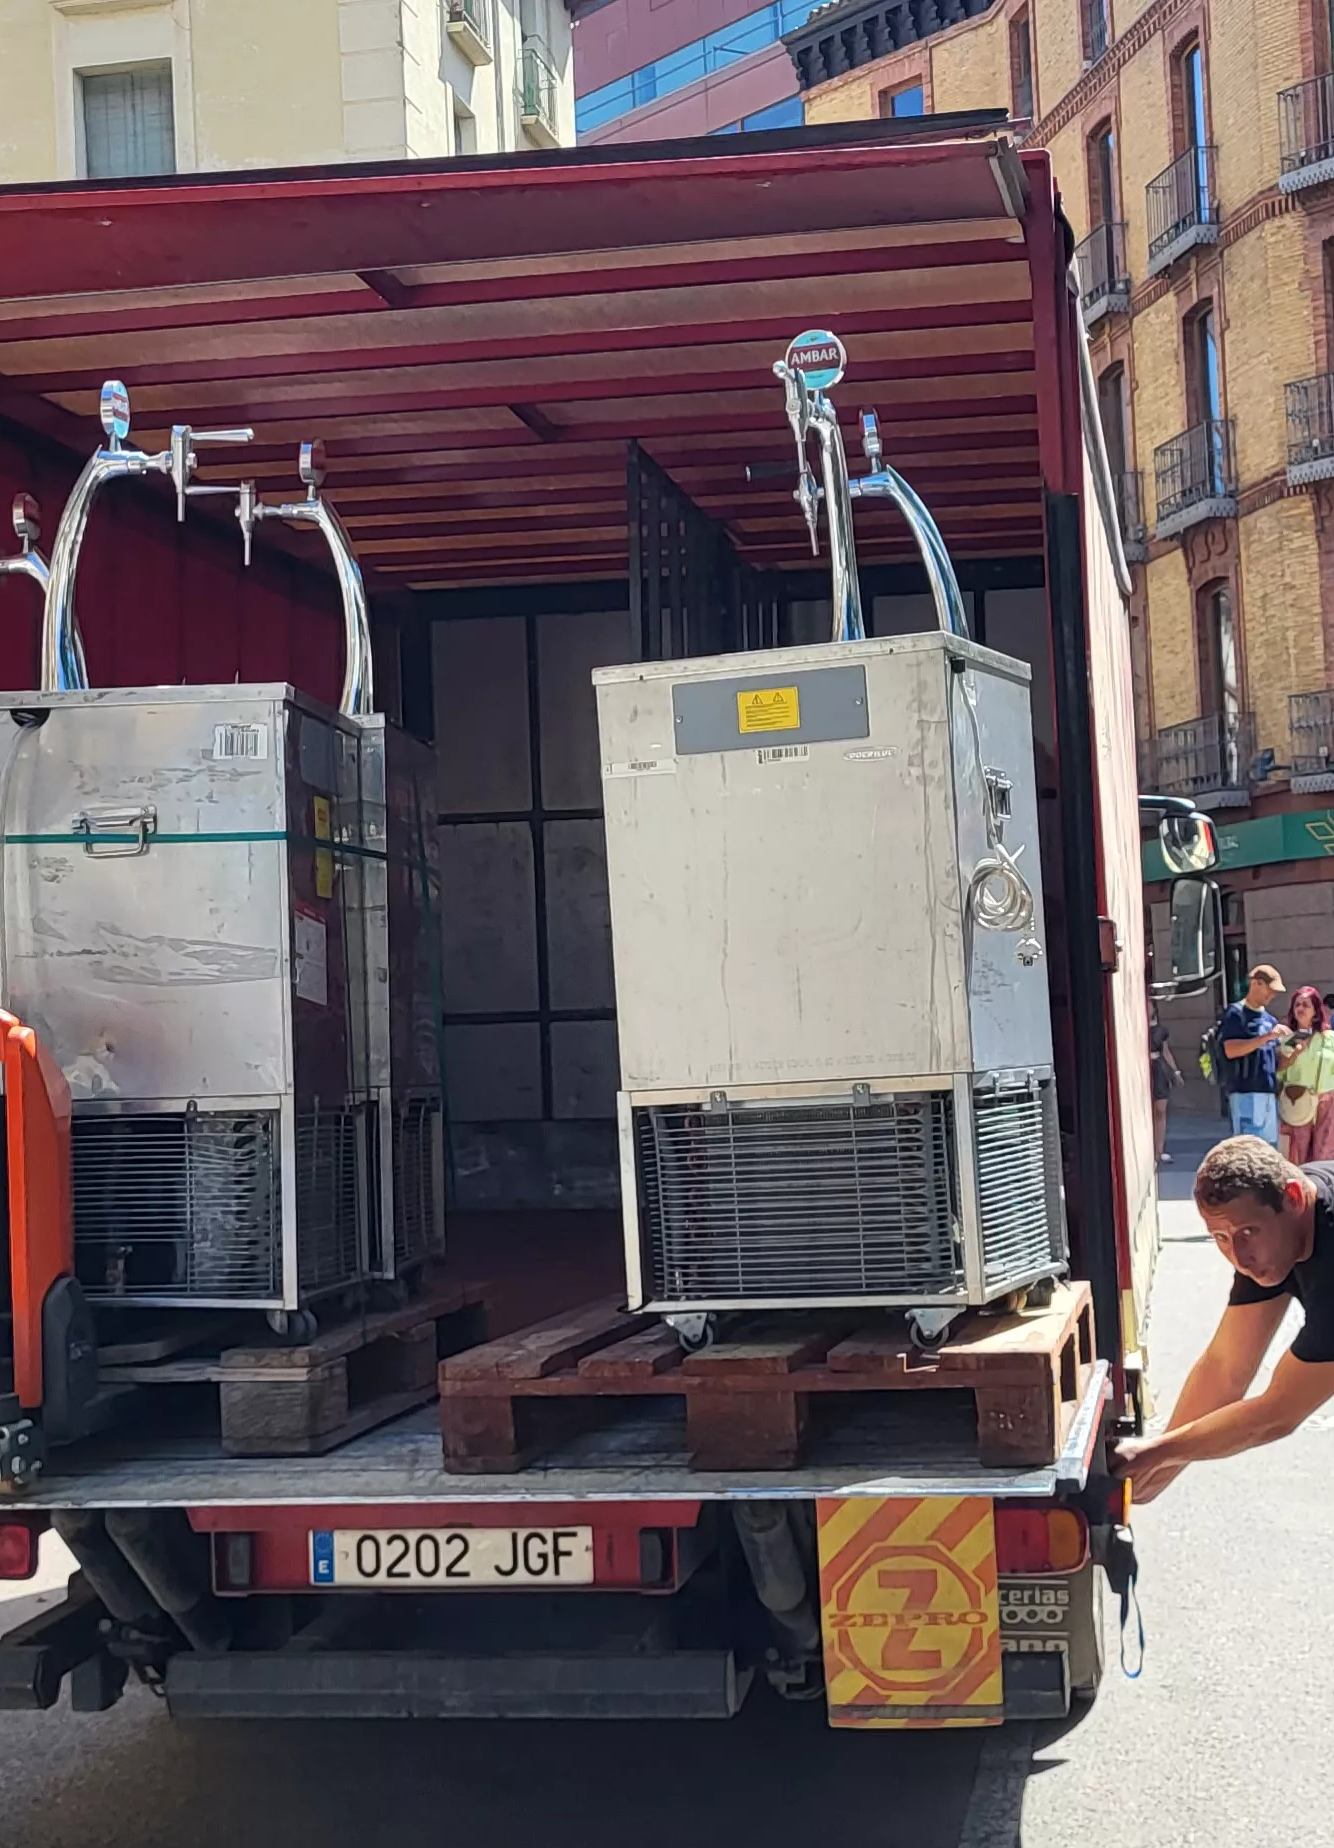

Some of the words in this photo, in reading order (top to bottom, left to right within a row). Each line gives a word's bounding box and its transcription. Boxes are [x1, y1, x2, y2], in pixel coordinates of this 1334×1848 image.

[791, 348, 839, 365] AMBAR
[318, 1560, 330, 1575] E
[356, 1533, 471, 1578] 0202
[494, 1531, 578, 1577] JGF
[828, 1611, 988, 1628] ZEPRO
